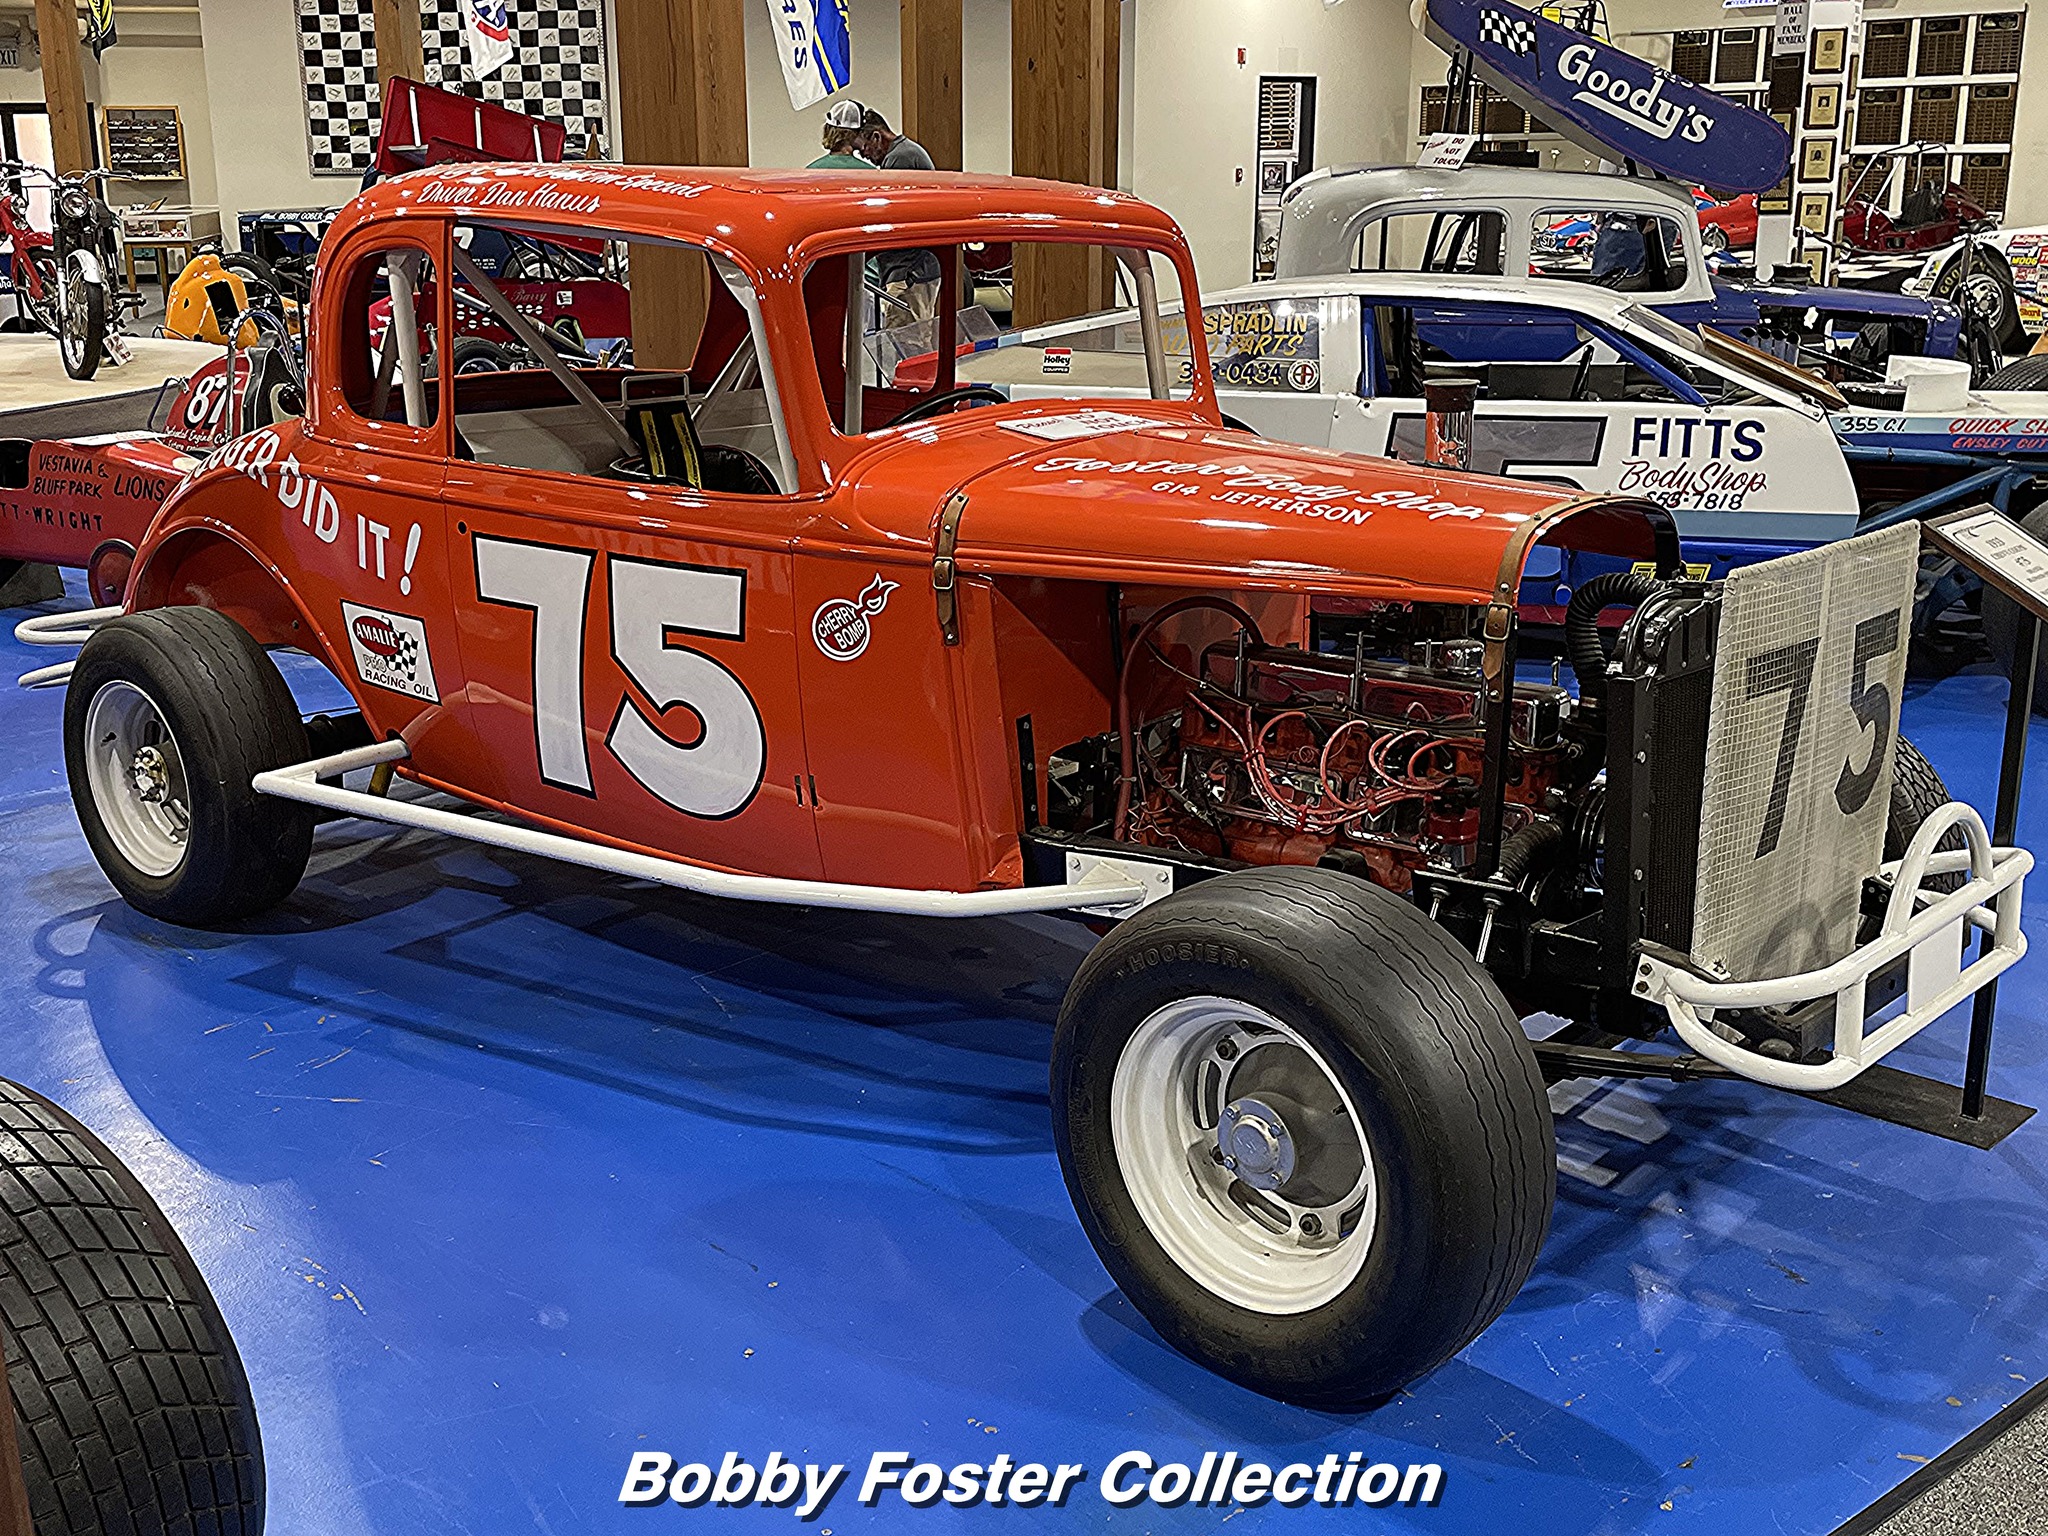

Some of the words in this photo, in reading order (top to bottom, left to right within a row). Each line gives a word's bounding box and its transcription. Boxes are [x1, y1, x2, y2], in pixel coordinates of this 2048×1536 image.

[1783, 5, 1803, 16] HALL
[1788, 16, 1797, 24] OF
[1776, 35, 1806, 45] MEMBERS
[1782, 25, 1802, 35] FAME
[1557, 43, 1716, 143] Goody's
[1443, 147, 1462, 156] NOT
[1451, 137, 1466, 145] DO
[1432, 156, 1461, 166] TOUCH
[478, 181, 529, 207] Dan
[1204, 311, 1309, 335] SPRADLIN
[1043, 355, 1071, 366] Holley
[1840, 417, 1878, 432] 355
[1949, 418, 2019, 434] QUICK
[1631, 417, 1767, 462] FITTS
[1952, 437, 2011, 448] ENSLEY
[39, 454, 93, 474] VESTAVIA
[33, 477, 66, 496] BLUFF
[68, 482, 103, 499] PARK
[113, 473, 165, 501] LIONS
[277, 453, 340, 543] DID
[1152, 481, 1200, 496] 614
[1210, 490, 1374, 525] JEFFERSON
[818, 606, 857, 637] CHERRY
[356, 622, 398, 648] AMALIE
[834, 619, 865, 650] BOMB
[365, 669, 406, 690] RACING
[413, 684, 433, 697] OIL
[471, 531, 768, 821] 75
[1747, 608, 1901, 860] 75
